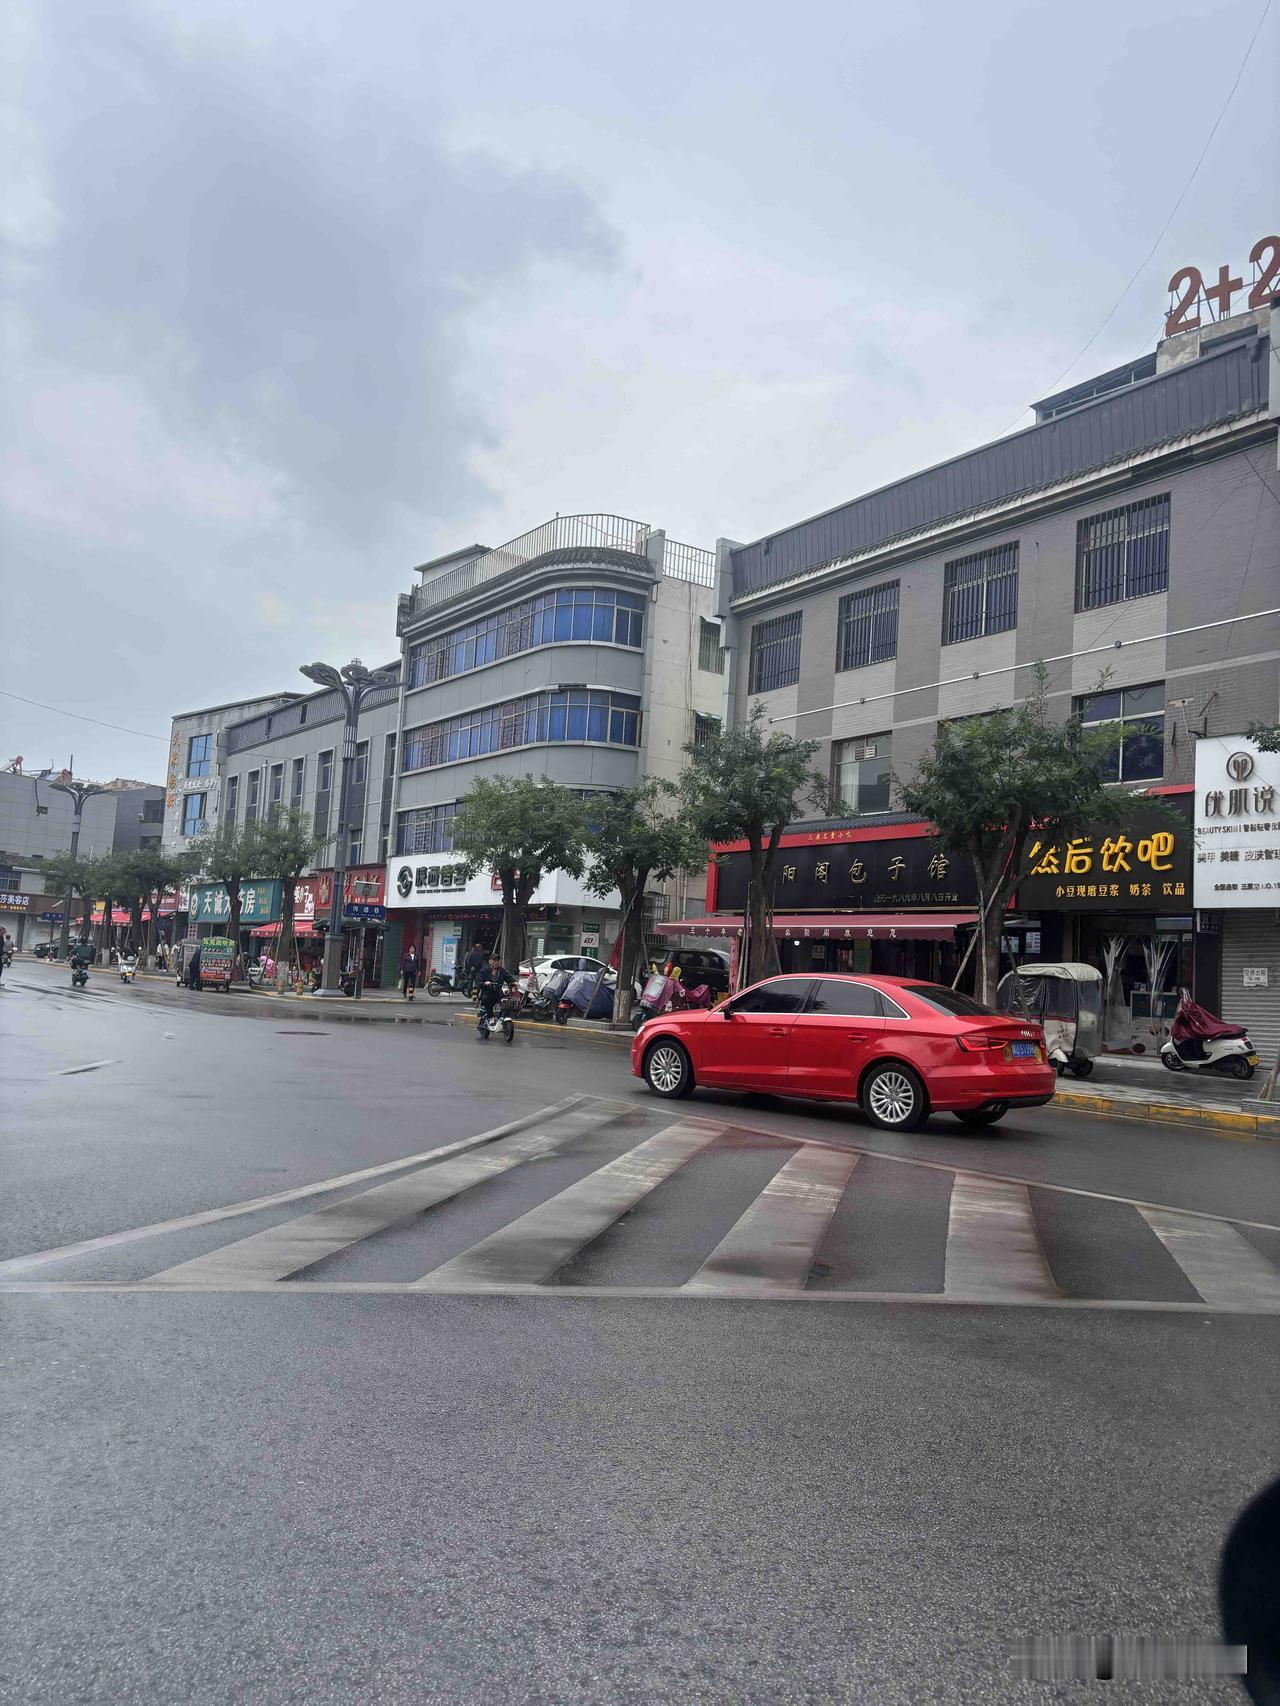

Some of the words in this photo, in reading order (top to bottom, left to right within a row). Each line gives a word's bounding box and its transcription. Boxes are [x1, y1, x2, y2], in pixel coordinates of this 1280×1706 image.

[1205, 786, 1275, 818] 优肌说
[1028, 831, 1175, 876] 然后饮吧
[1129, 883, 1152, 896] 奶茶
[1162, 882, 1185, 896] 饮品
